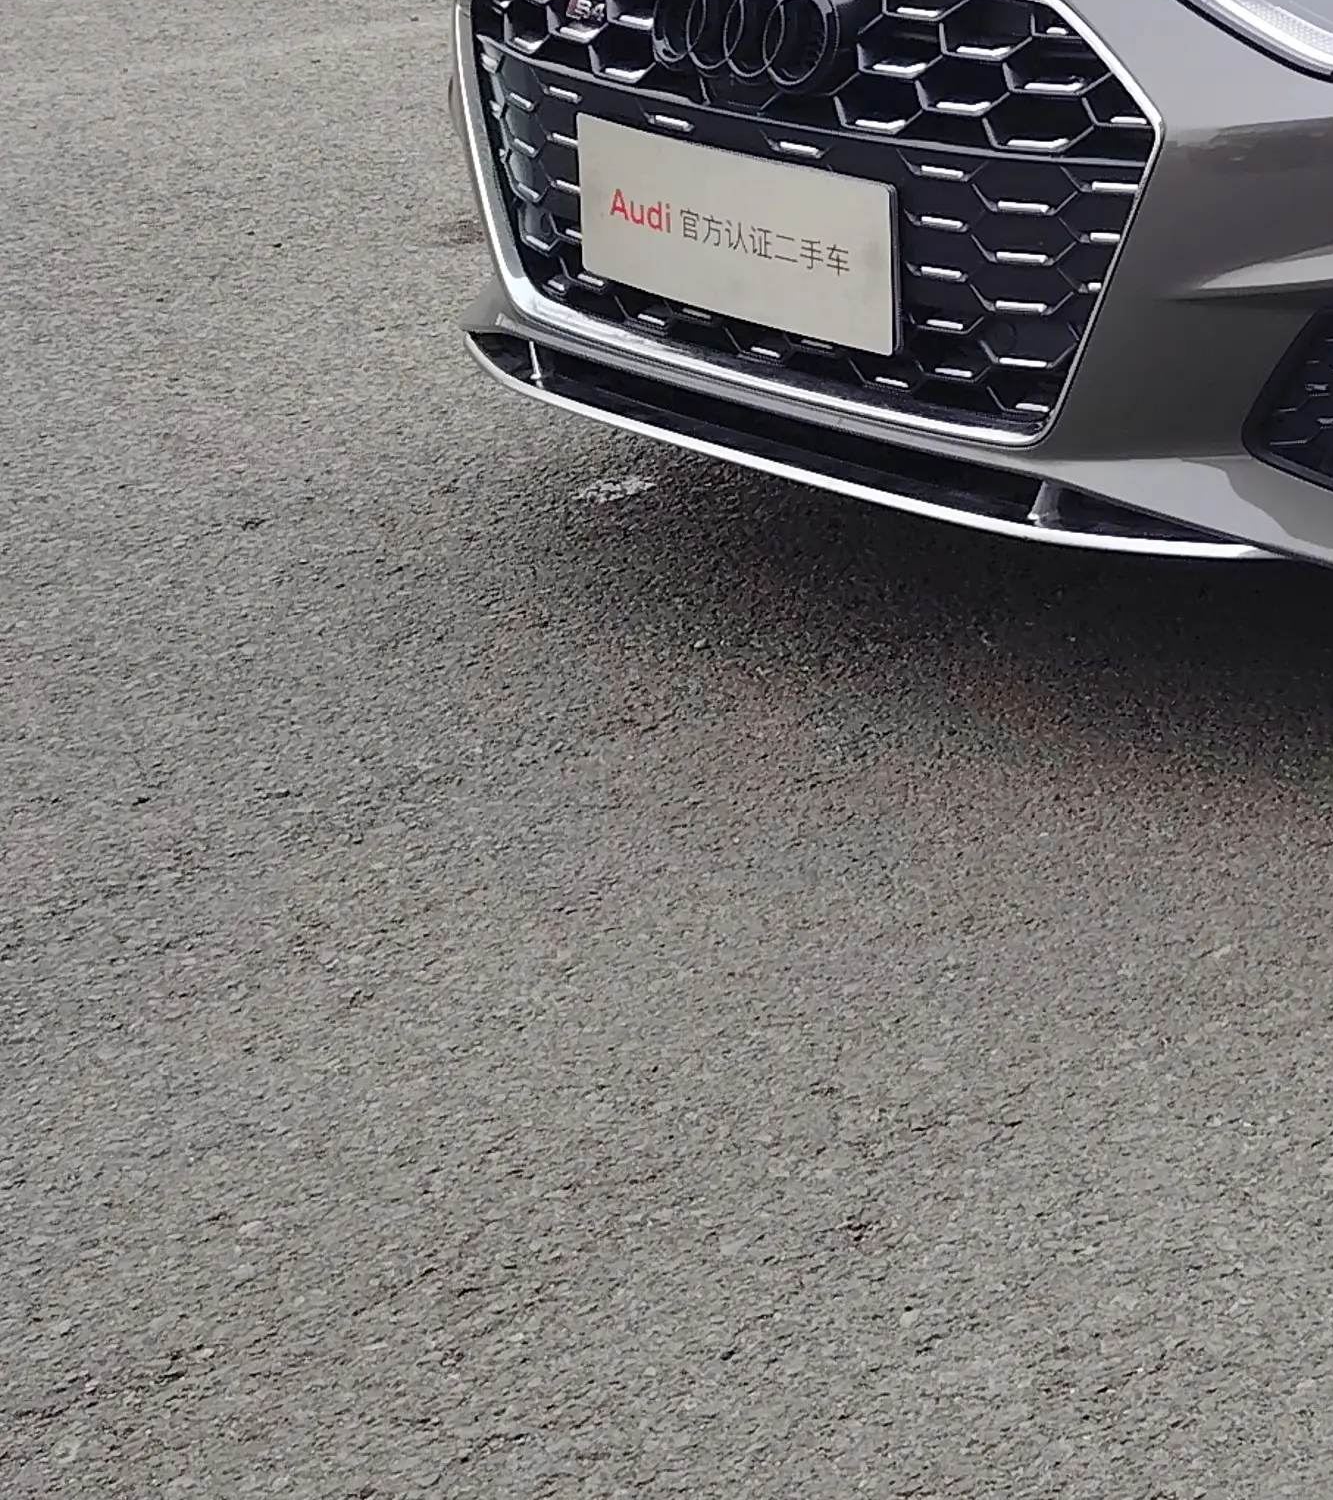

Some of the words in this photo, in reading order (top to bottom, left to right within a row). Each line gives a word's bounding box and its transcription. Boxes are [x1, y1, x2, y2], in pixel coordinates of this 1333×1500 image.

[610, 188, 671, 233] Audi
[680, 208, 850, 276] 官方认证二手车
